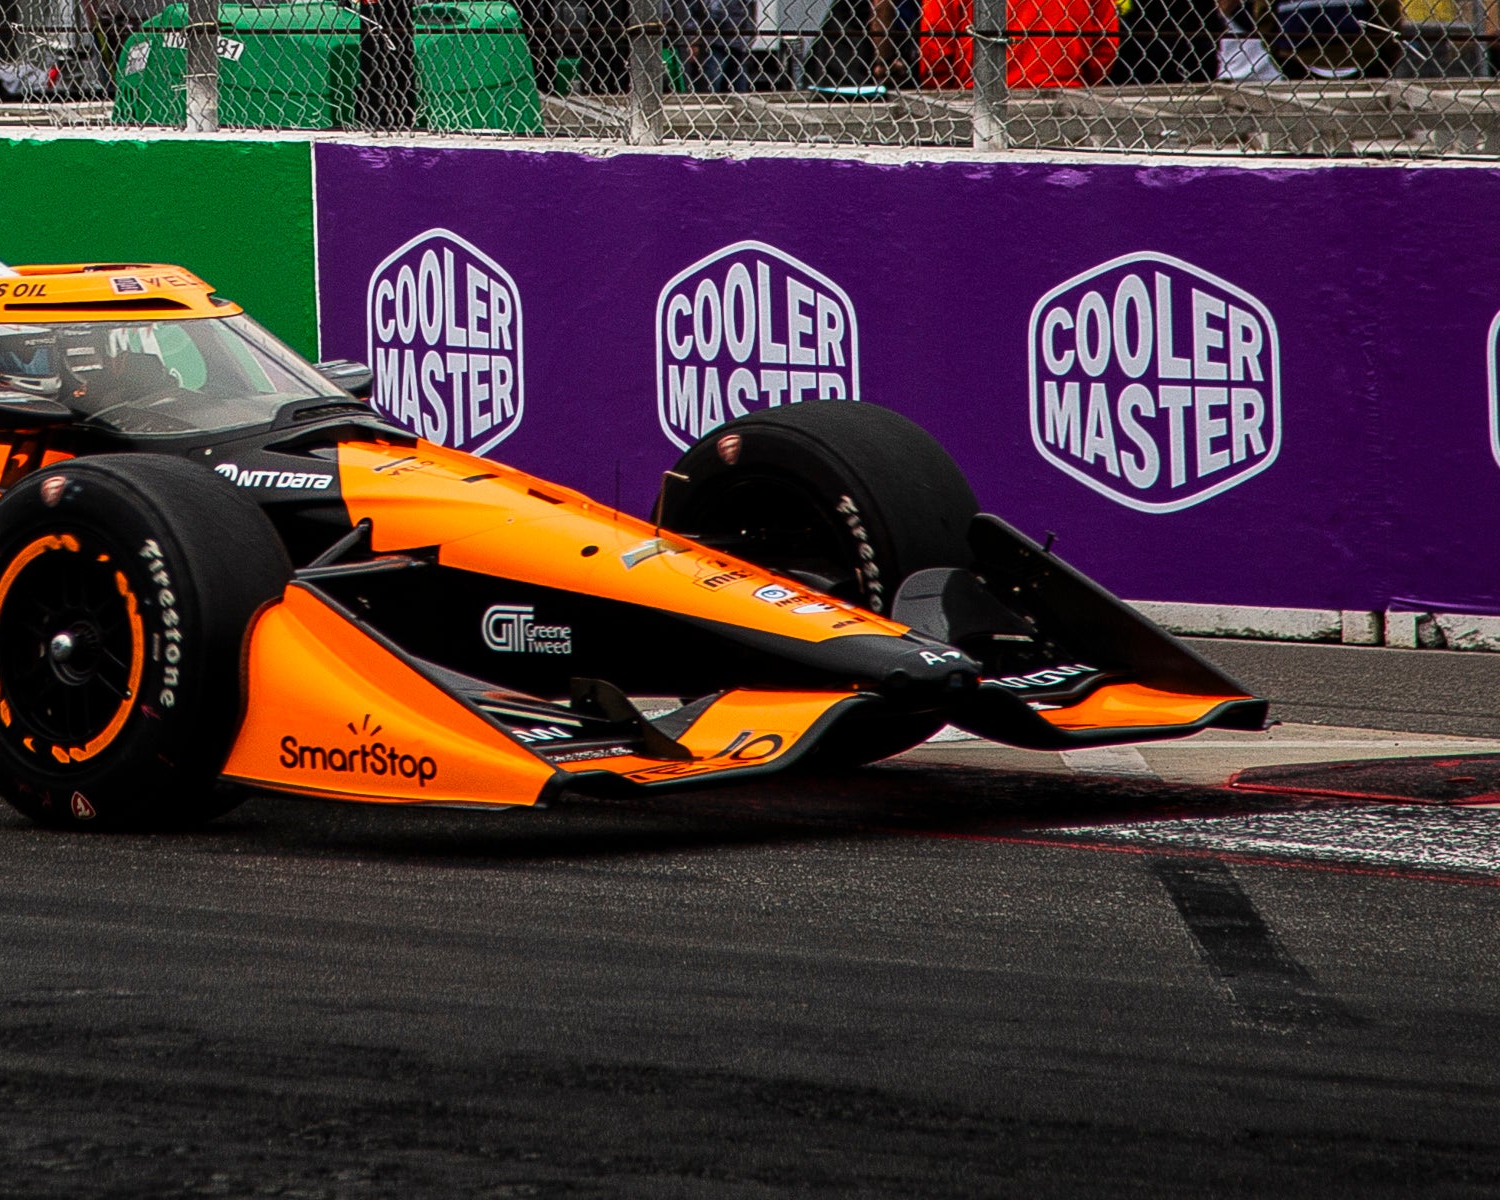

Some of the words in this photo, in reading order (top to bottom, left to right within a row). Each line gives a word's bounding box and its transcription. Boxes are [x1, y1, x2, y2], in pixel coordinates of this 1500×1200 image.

[12, 281, 47, 299] OIL
[375, 247, 513, 351] COOLER
[667, 260, 846, 367] COOLER
[1042, 271, 1264, 382] COOLER
[375, 347, 514, 448] MASTER
[668, 364, 846, 437] MAS
[1043, 381, 1266, 488] MASTER
[139, 538, 183, 708] Firestone
[525, 623, 572, 639] Greene
[526, 638, 573, 654] Tweed
[279, 735, 438, 788] SmartStop
